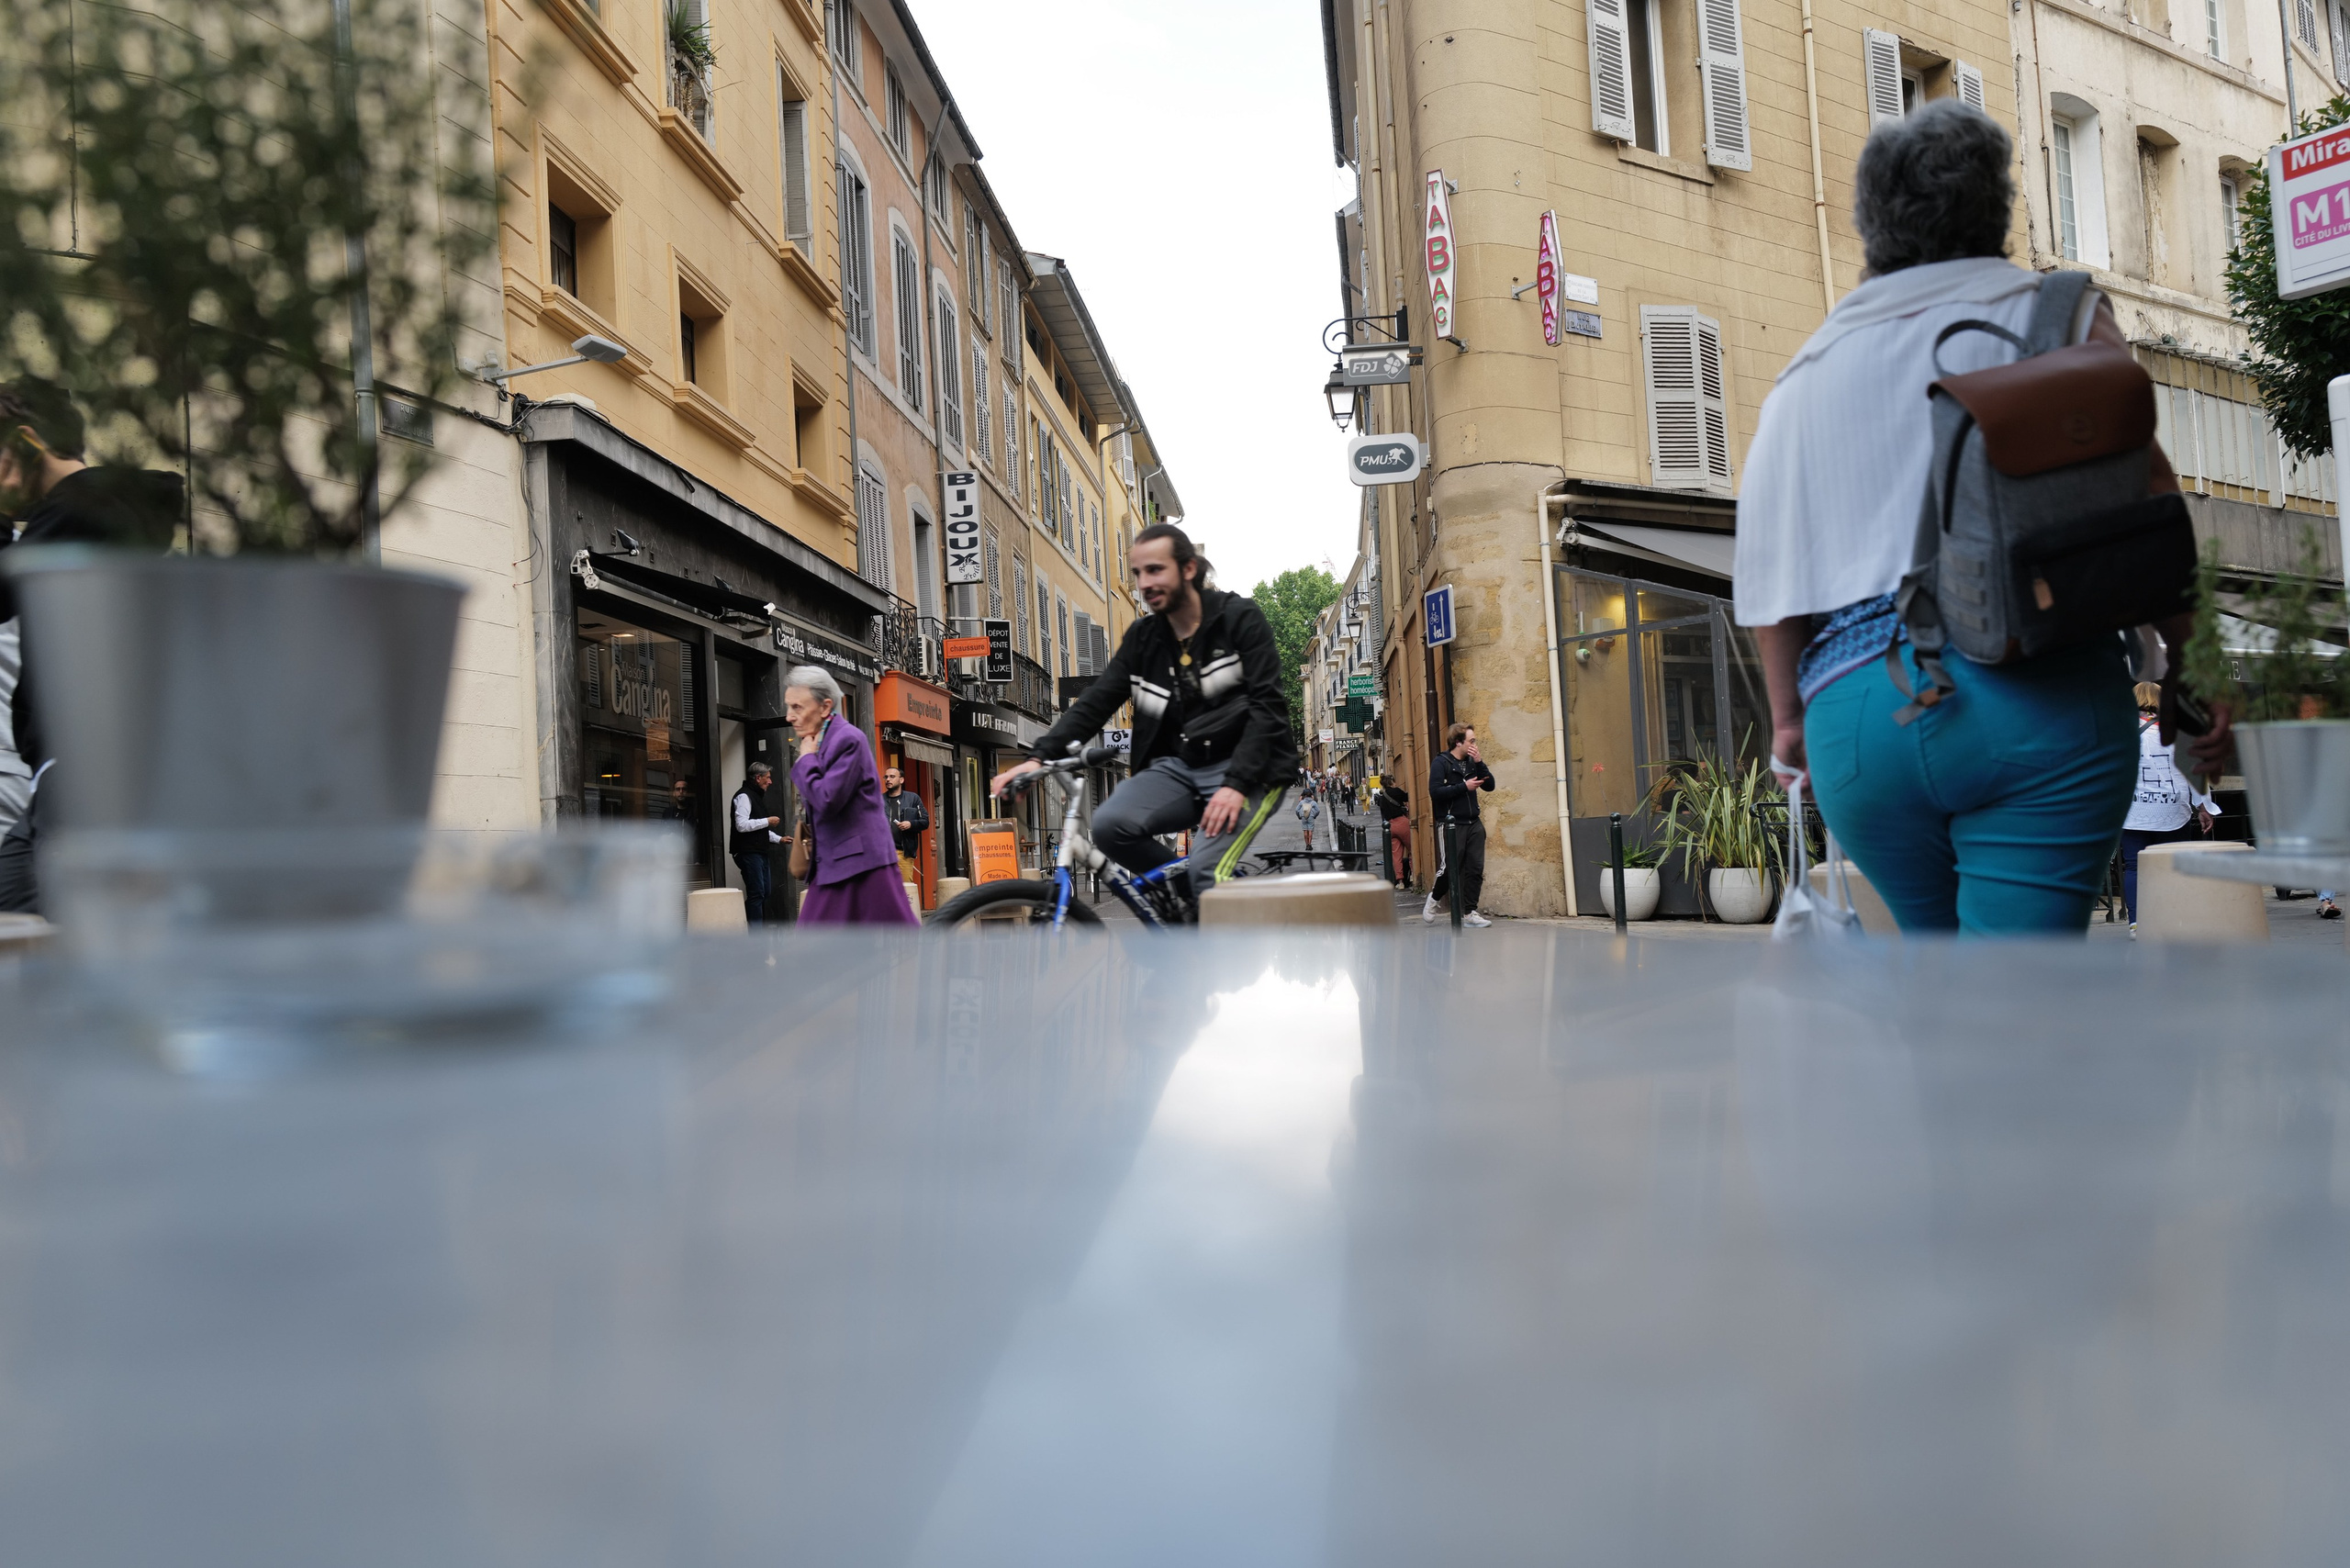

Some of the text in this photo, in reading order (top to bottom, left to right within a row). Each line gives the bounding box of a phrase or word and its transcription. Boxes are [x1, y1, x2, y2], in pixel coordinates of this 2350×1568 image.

[2291, 137, 2350, 172] Mira
[2297, 186, 2350, 233] M1
[2295, 222, 2350, 246] CITÉ DU LIV
[1427, 180, 1449, 325] TABAC
[1537, 216, 1555, 341] TABAC
[1352, 361, 1378, 374] FDJ
[400, 404, 414, 415] RUE
[1360, 454, 1388, 466] PMU
[947, 473, 979, 566] BIJOUX
[950, 644, 985, 653] chaussure
[988, 665, 1011, 673] LUXE
[906, 692, 942, 722] Empreinte
[974, 844, 1013, 852] empreinte
